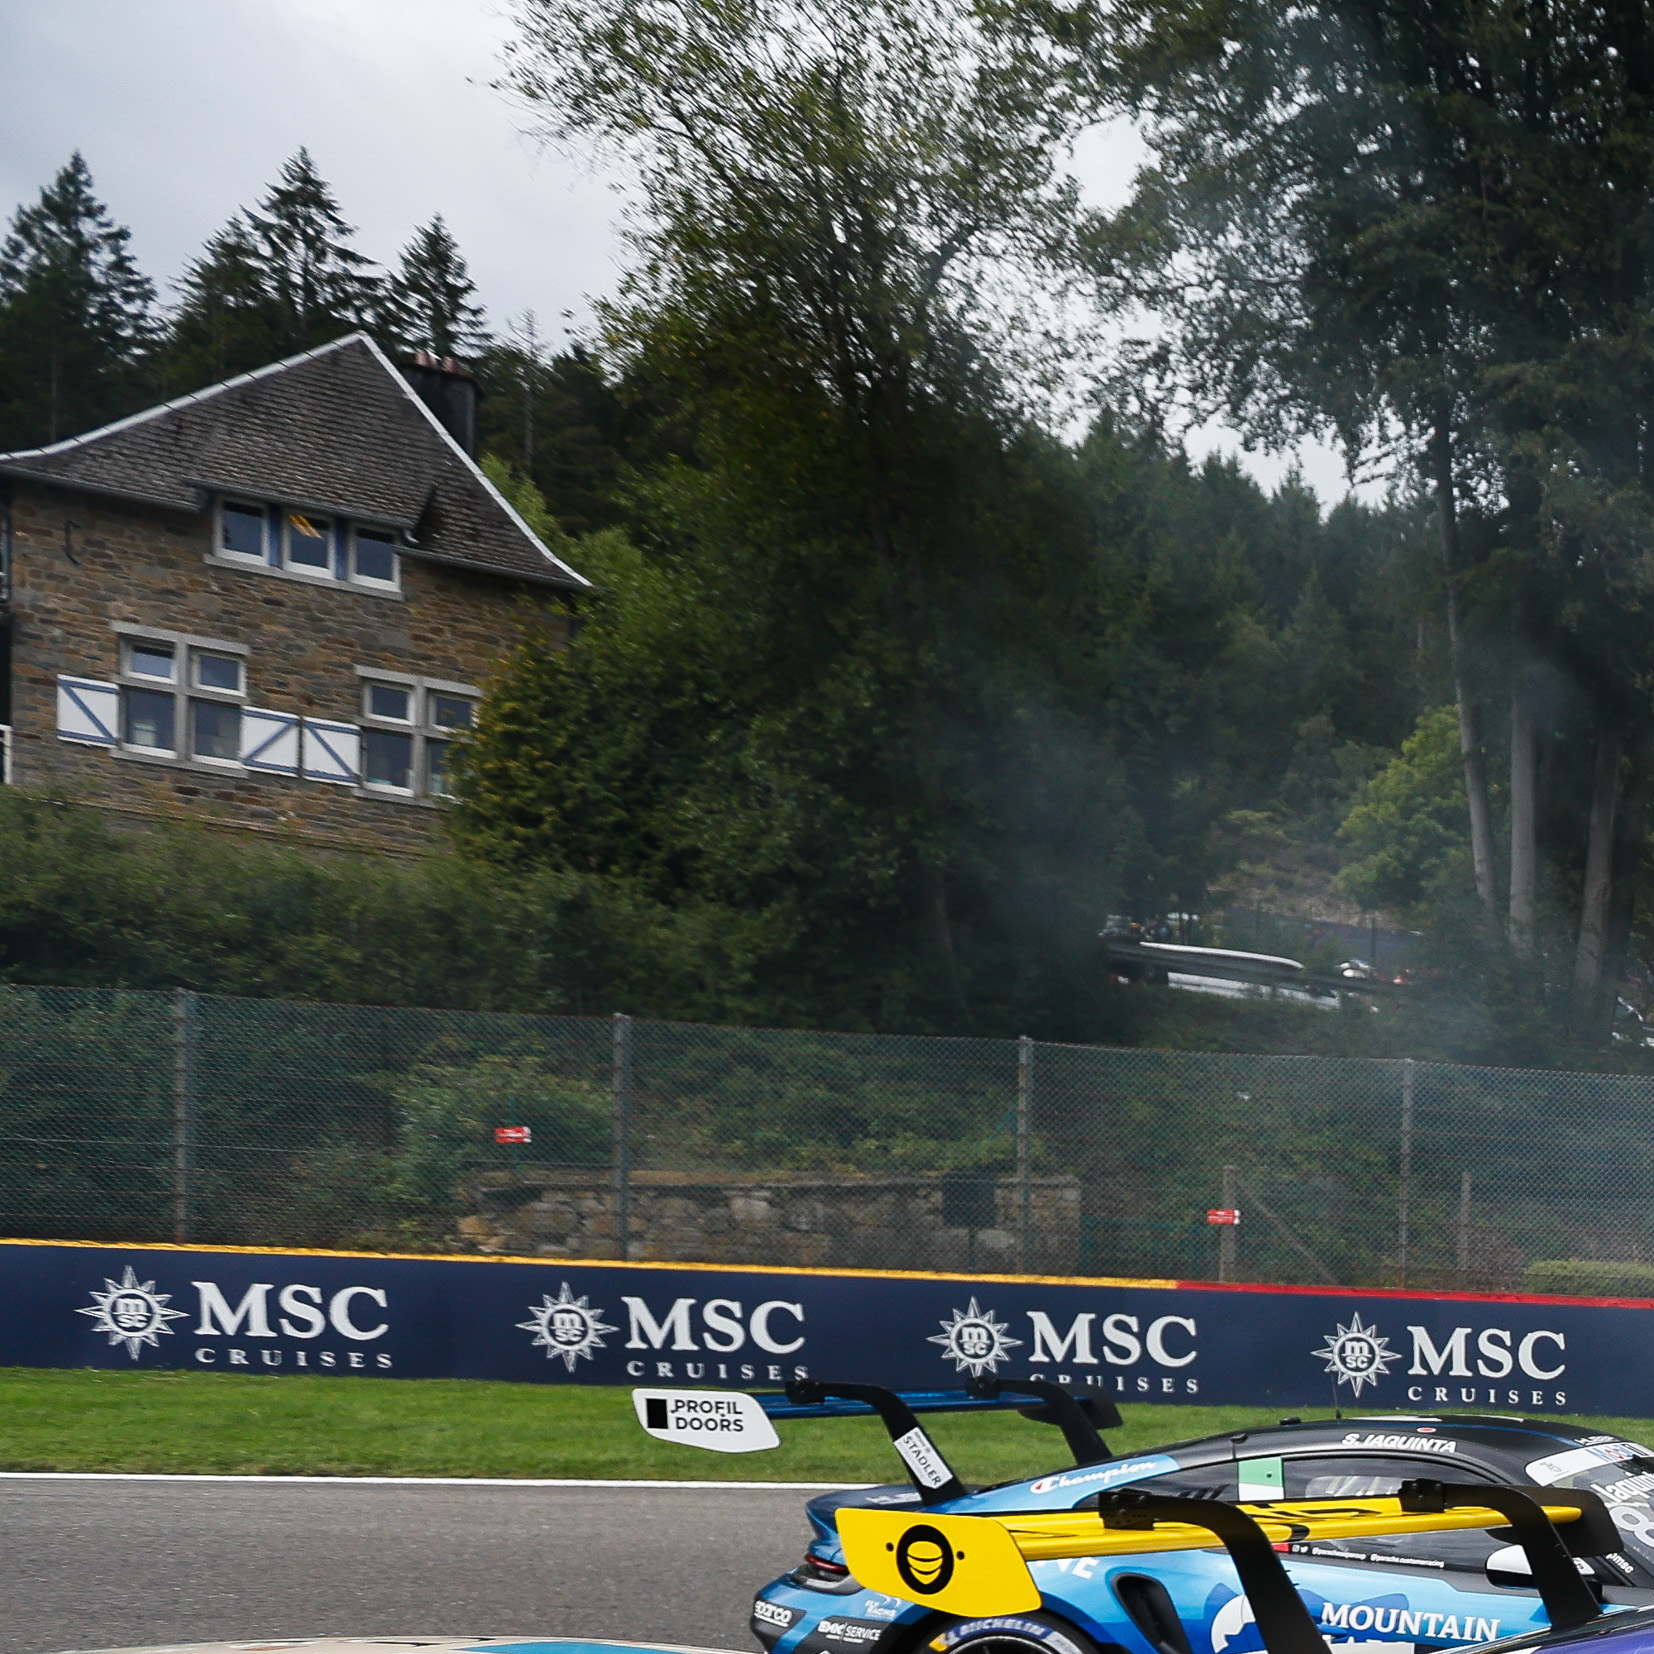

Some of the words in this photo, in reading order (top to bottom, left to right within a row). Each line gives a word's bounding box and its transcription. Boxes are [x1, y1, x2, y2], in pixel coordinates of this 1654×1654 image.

[192, 1282, 388, 1340] MSC
[622, 1297, 804, 1353] MSC
[1027, 1311, 1196, 1367] MSC
[195, 1349, 391, 1368] CRUISES
[1407, 1326, 1565, 1379] MSC
[627, 1361, 808, 1380] CRUISES
[673, 1399, 744, 1416] PROFIL
[1408, 1387, 1565, 1405] CRUISES
[675, 1416, 745, 1432] DOORS
[902, 1435, 942, 1486] STADLER
[1030, 1460, 1159, 1494] Champion
[845, 1625, 882, 1641] SERVICE
[959, 1618, 1046, 1635] MICHELIN
[1321, 1602, 1501, 1643] MOUNTAIN
